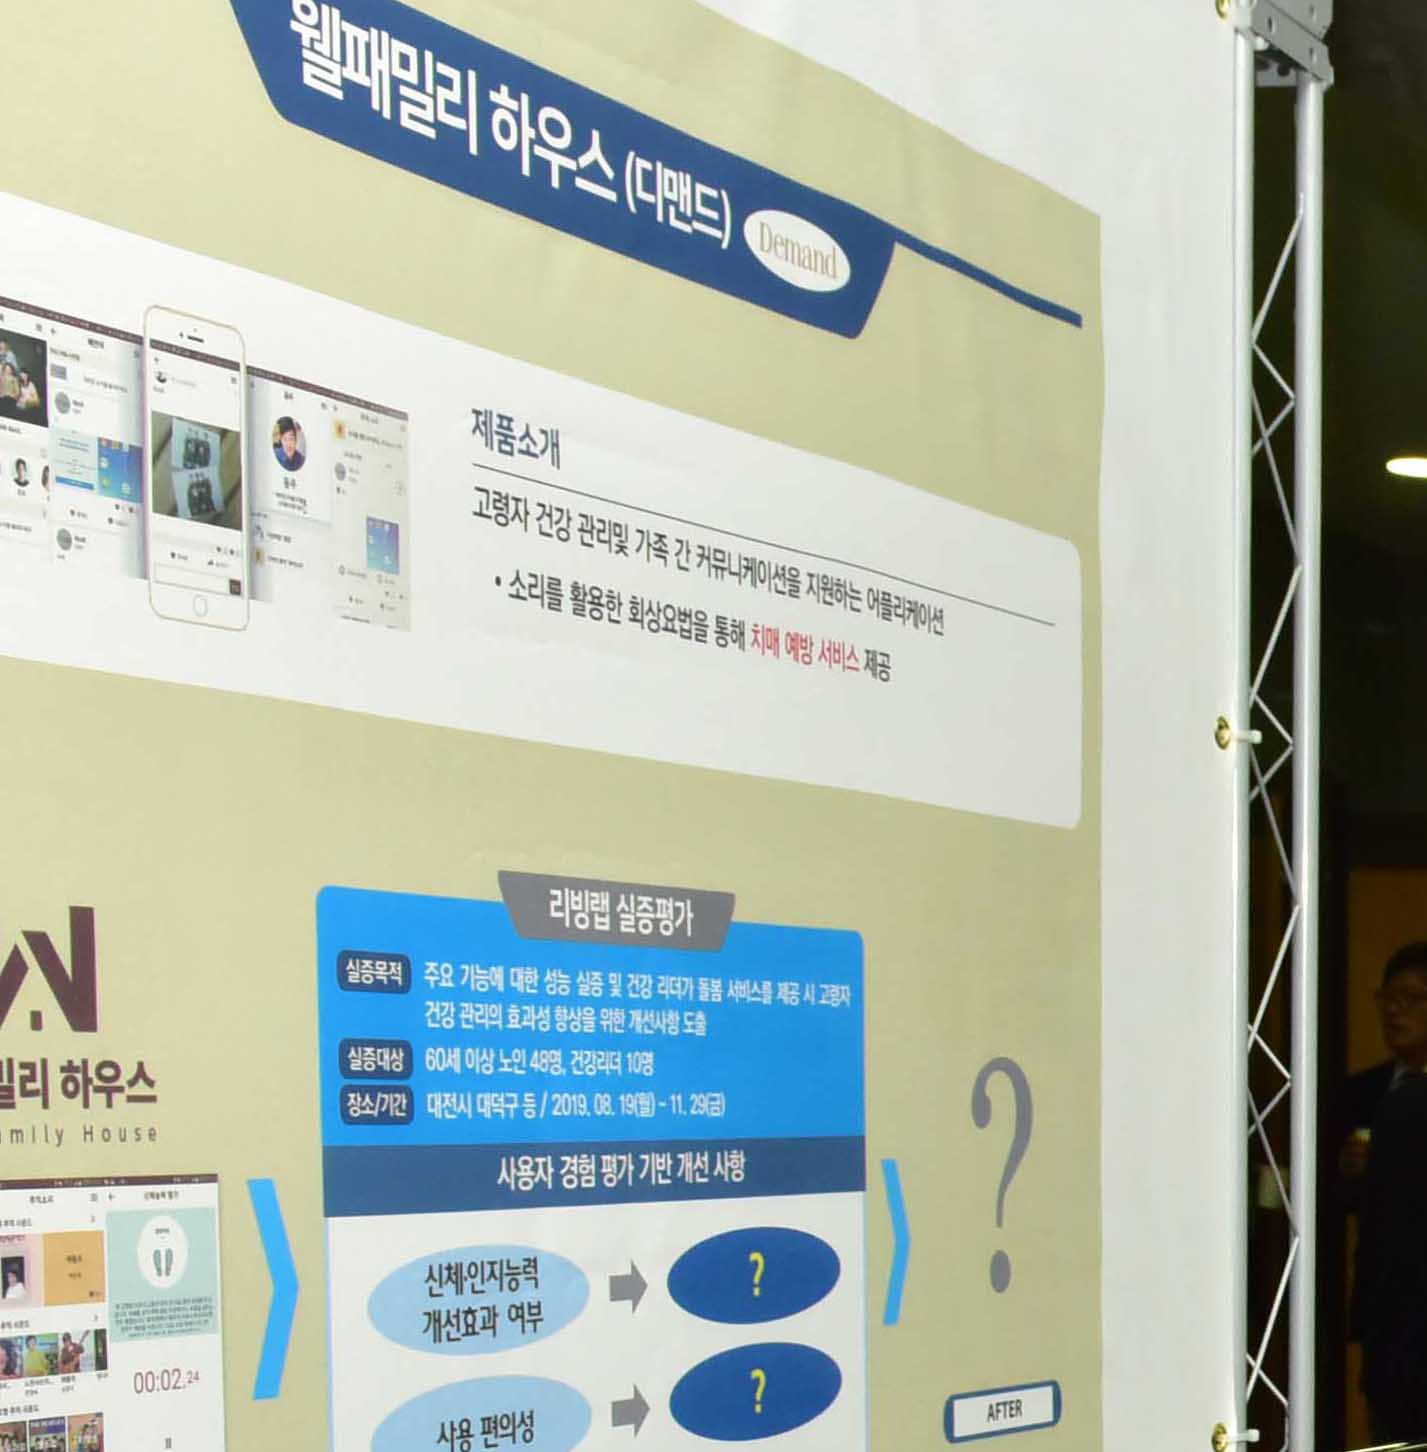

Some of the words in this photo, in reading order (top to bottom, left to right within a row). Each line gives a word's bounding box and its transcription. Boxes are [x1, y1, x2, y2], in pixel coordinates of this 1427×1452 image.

[289, 0, 478, 155] 웰패밀리
[489, 84, 617, 203] 하우스
[625, 151, 732, 249] (디맨드)
[759, 221, 838, 279] Demand
[471, 407, 562, 470] 제품소개
[472, 486, 531, 532] 고령자
[535, 501, 572, 543] 건강
[577, 513, 629, 557] 관리및
[635, 527, 670, 567] 가족
[674, 536, 691, 571] 간
[696, 543, 801, 599] 커뮤니케이션을
[805, 571, 862, 614] 지원하는
[866, 586, 945, 636] 어플리케이션
[508, 569, 564, 612] 소리를
[569, 581, 623, 626] 활용한
[628, 594, 710, 644] 회상요법을
[713, 615, 746, 651] 통해
[751, 622, 780, 658] 치매
[785, 629, 814, 665] 예방
[818, 639, 860, 673] 서비스
[863, 649, 892, 683] 제공
[549, 888, 610, 931] 리빙랩
[616, 892, 694, 938] 실증평가
[345, 959, 403, 986] 실증목적
[423, 961, 454, 988] 주요
[460, 964, 503, 992] 기능에
[509, 966, 539, 994] 대한
[544, 969, 572, 996] 성능
[576, 971, 604, 999] 실증
[608, 972, 622, 999] 및
[627, 973, 653, 1000] 건강
[657, 975, 693, 1001] 리더가
[698, 977, 724, 1003] 돌봄
[727, 979, 773, 1005] 서비스를
[777, 981, 801, 1006] 제공
[803, 982, 815, 1006] 시
[424, 1001, 455, 1029] 건강
[459, 1002, 503, 1031] 관리의
[507, 1003, 551, 1033] 효과성
[554, 1005, 596, 1034] 향상을
[600, 1008, 626, 1034] 위한
[628, 1009, 681, 1037] 개선사항
[683, 1010, 708, 1037] 도출
[347, 1047, 405, 1073] 실증대상
[425, 1047, 461, 1074] 60세
[465, 1048, 495, 1076] 이상
[499, 1048, 527, 1075] 노인
[570, 1050, 622, 1077] 건강리더
[626, 1050, 655, 1077] 10명
[60, 1057, 158, 1110] 하우스
[346, 1092, 408, 1118] 장소/기간
[426, 1091, 472, 1120] 대전시
[476, 1091, 519, 1120] 대덕구
[523, 1092, 537, 1119] 등
[539, 1091, 548, 1120] /
[551, 1092, 591, 1118] 2019.
[594, 1092, 615, 1118] 08.
[0, 1123, 64, 1147] mily
[83, 1123, 157, 1143] House
[497, 1154, 555, 1192] 사용자
[559, 1153, 596, 1190] 경험
[601, 1152, 635, 1188] 평가
[639, 1151, 672, 1186] 기반
[677, 1150, 709, 1184] 개선
[713, 1149, 747, 1183] 사항
[971, 1056, 1034, 1293] ?
[750, 1252, 765, 1297] ?
[422, 1303, 499, 1344] 개선효과
[507, 1300, 544, 1335] 여부
[751, 1368, 767, 1413] ?
[987, 1398, 1023, 1424] AFTER
[480, 1409, 535, 1450] 편의성
